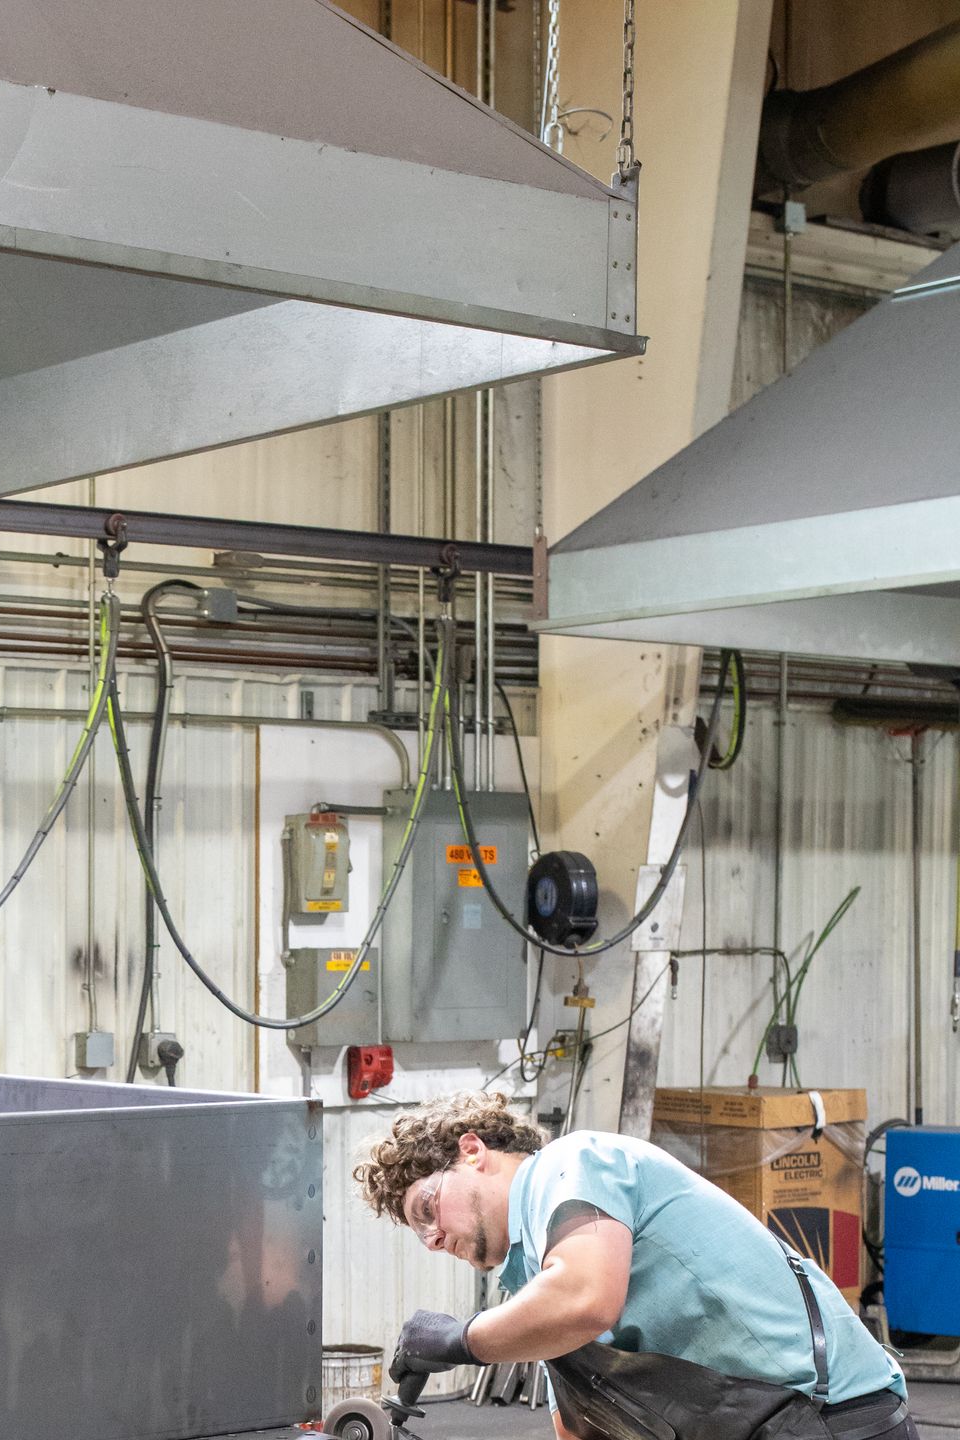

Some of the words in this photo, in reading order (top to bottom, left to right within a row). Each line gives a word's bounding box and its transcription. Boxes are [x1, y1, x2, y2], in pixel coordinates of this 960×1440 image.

[449, 848, 465, 860] 480
[466, 849, 495, 861] VTS
[773, 1153, 819, 1169] LINCOLN
[784, 1169, 823, 1180] ELECTRIC
[922, 1175, 959, 1191] Miller
